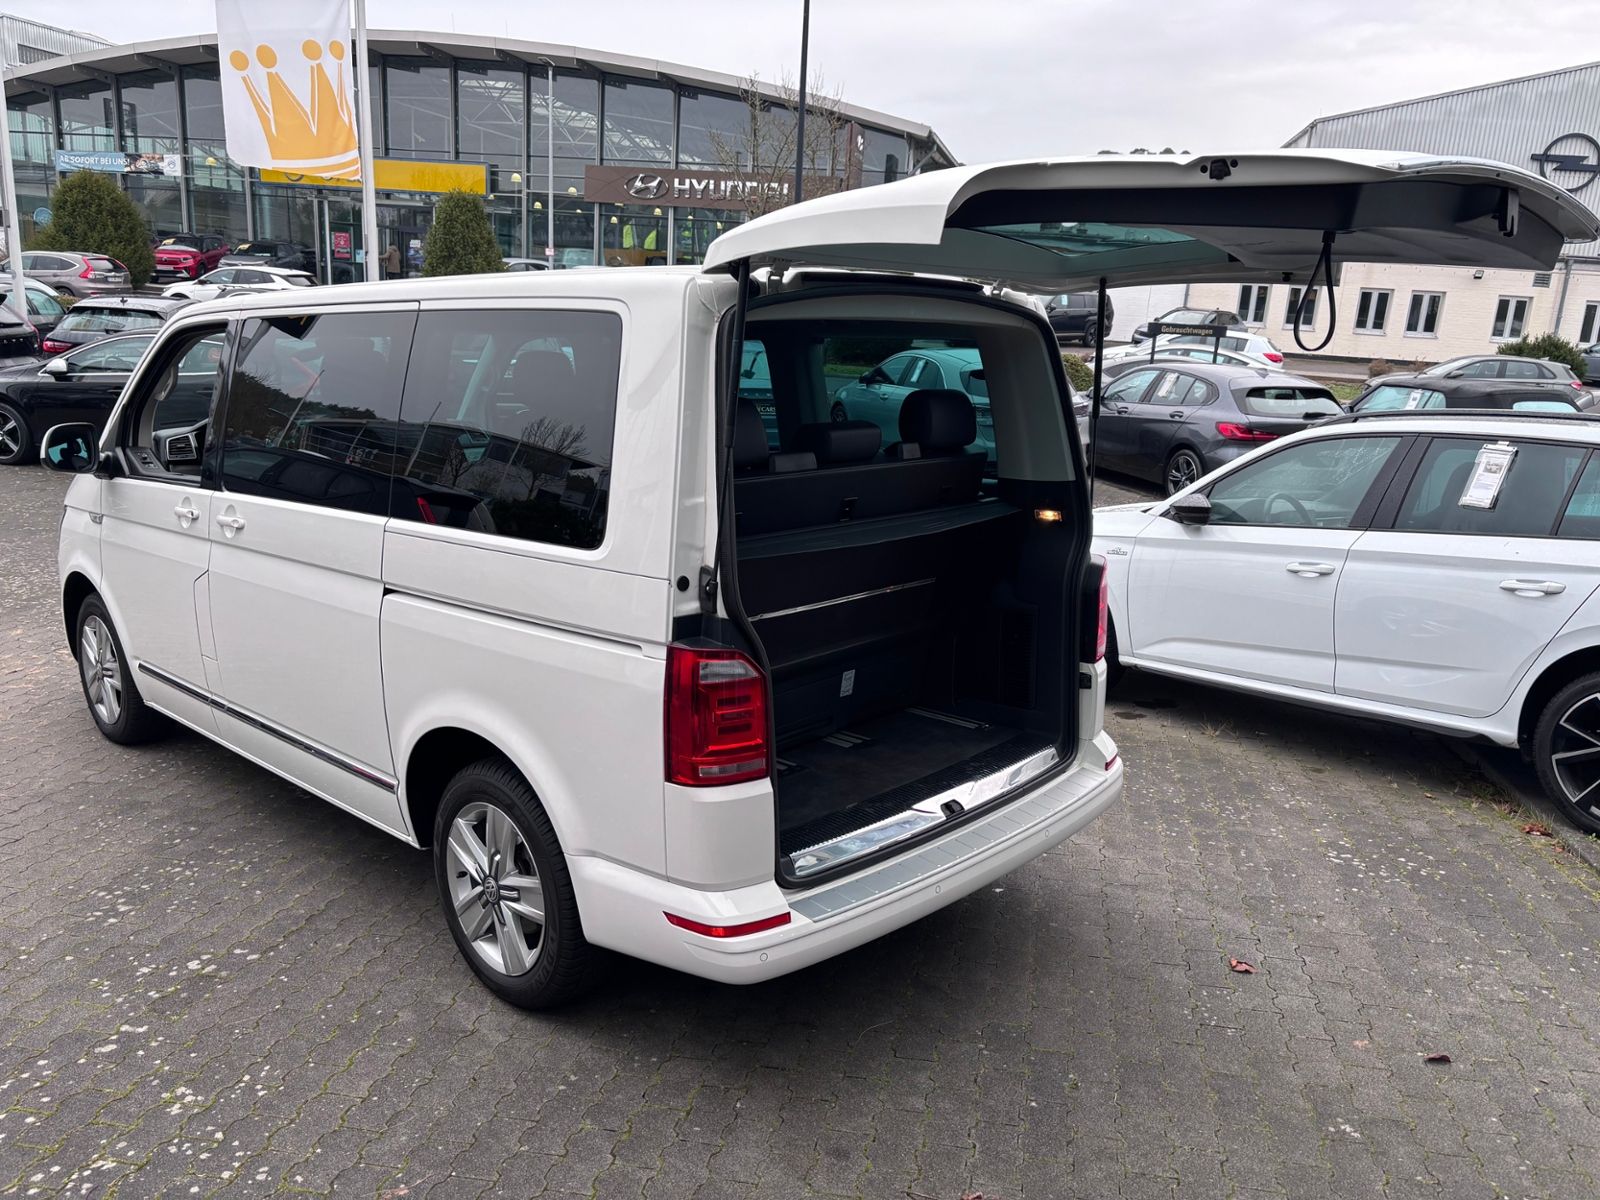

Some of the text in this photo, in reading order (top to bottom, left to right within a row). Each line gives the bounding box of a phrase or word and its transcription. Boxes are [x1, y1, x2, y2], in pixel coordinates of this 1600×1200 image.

[70, 155, 98, 165] SOFORT
[100, 157, 112, 165] BEI
[113, 158, 130, 166] UNS!
[673, 177, 789, 202] HYUNDAI
[1161, 325, 1213, 336] Gebrauchtwagen
